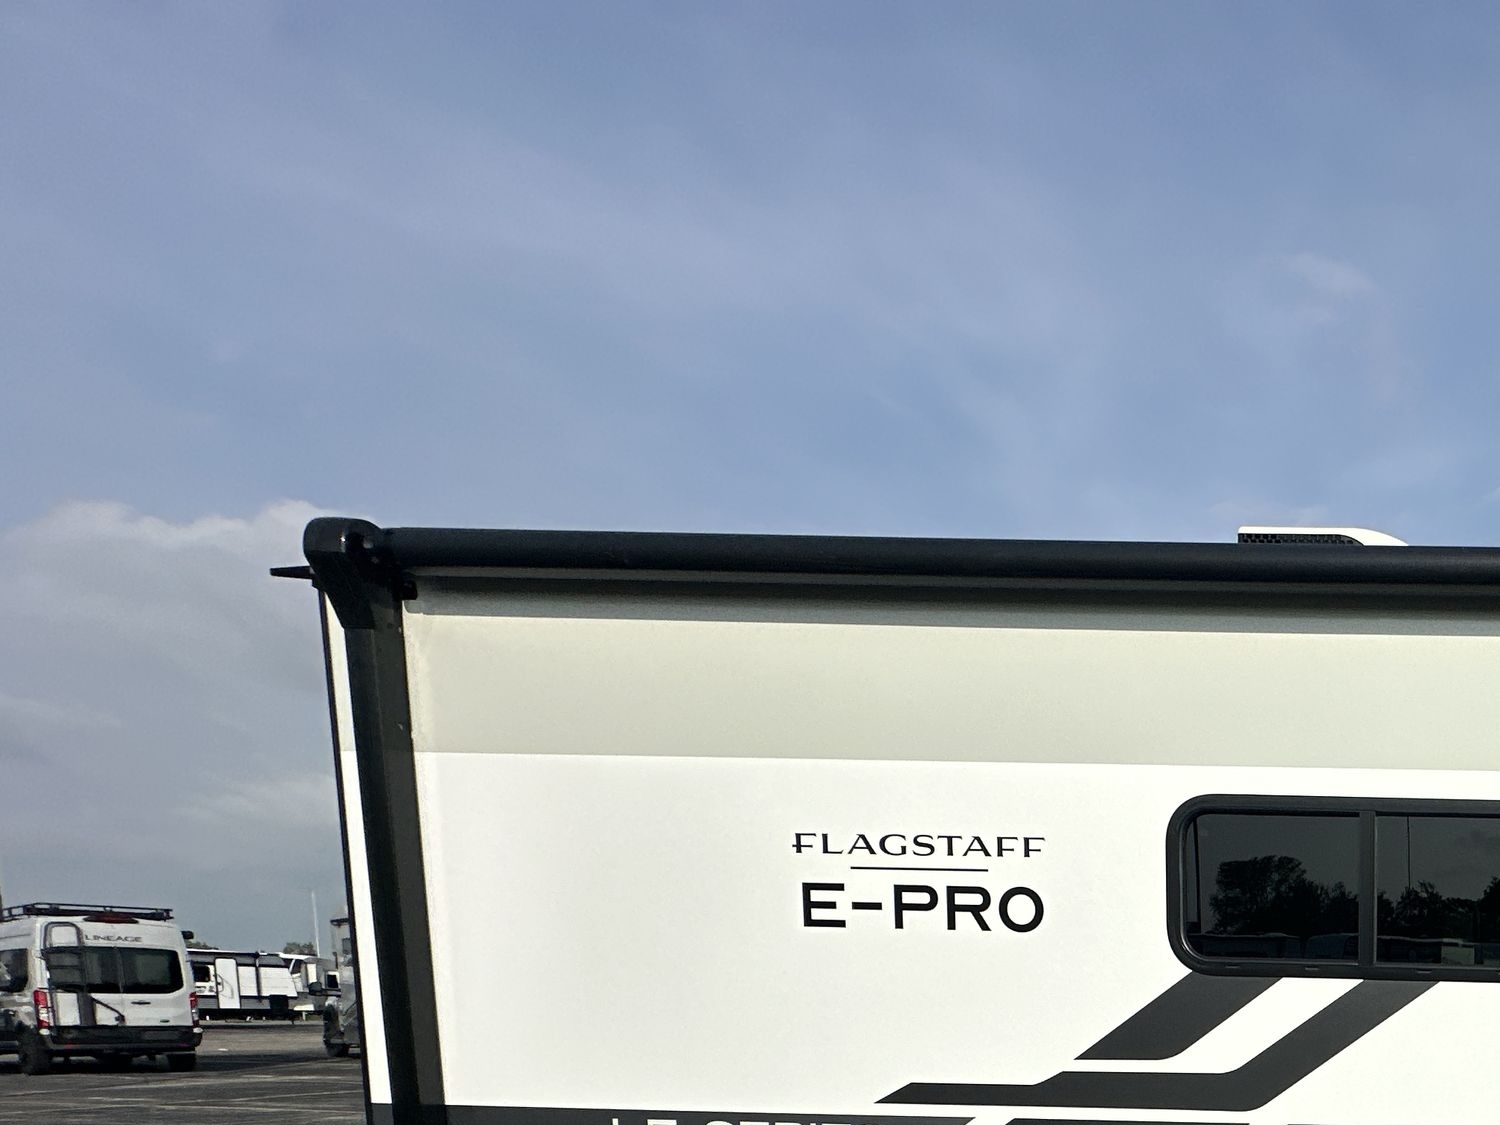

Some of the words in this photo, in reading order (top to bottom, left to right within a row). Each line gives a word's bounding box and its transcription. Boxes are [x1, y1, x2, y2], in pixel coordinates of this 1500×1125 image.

[791, 832, 1046, 858] FLAGSTAFF
[801, 881, 1045, 934] E-PRO
[84, 934, 143, 943] LINEAGE
